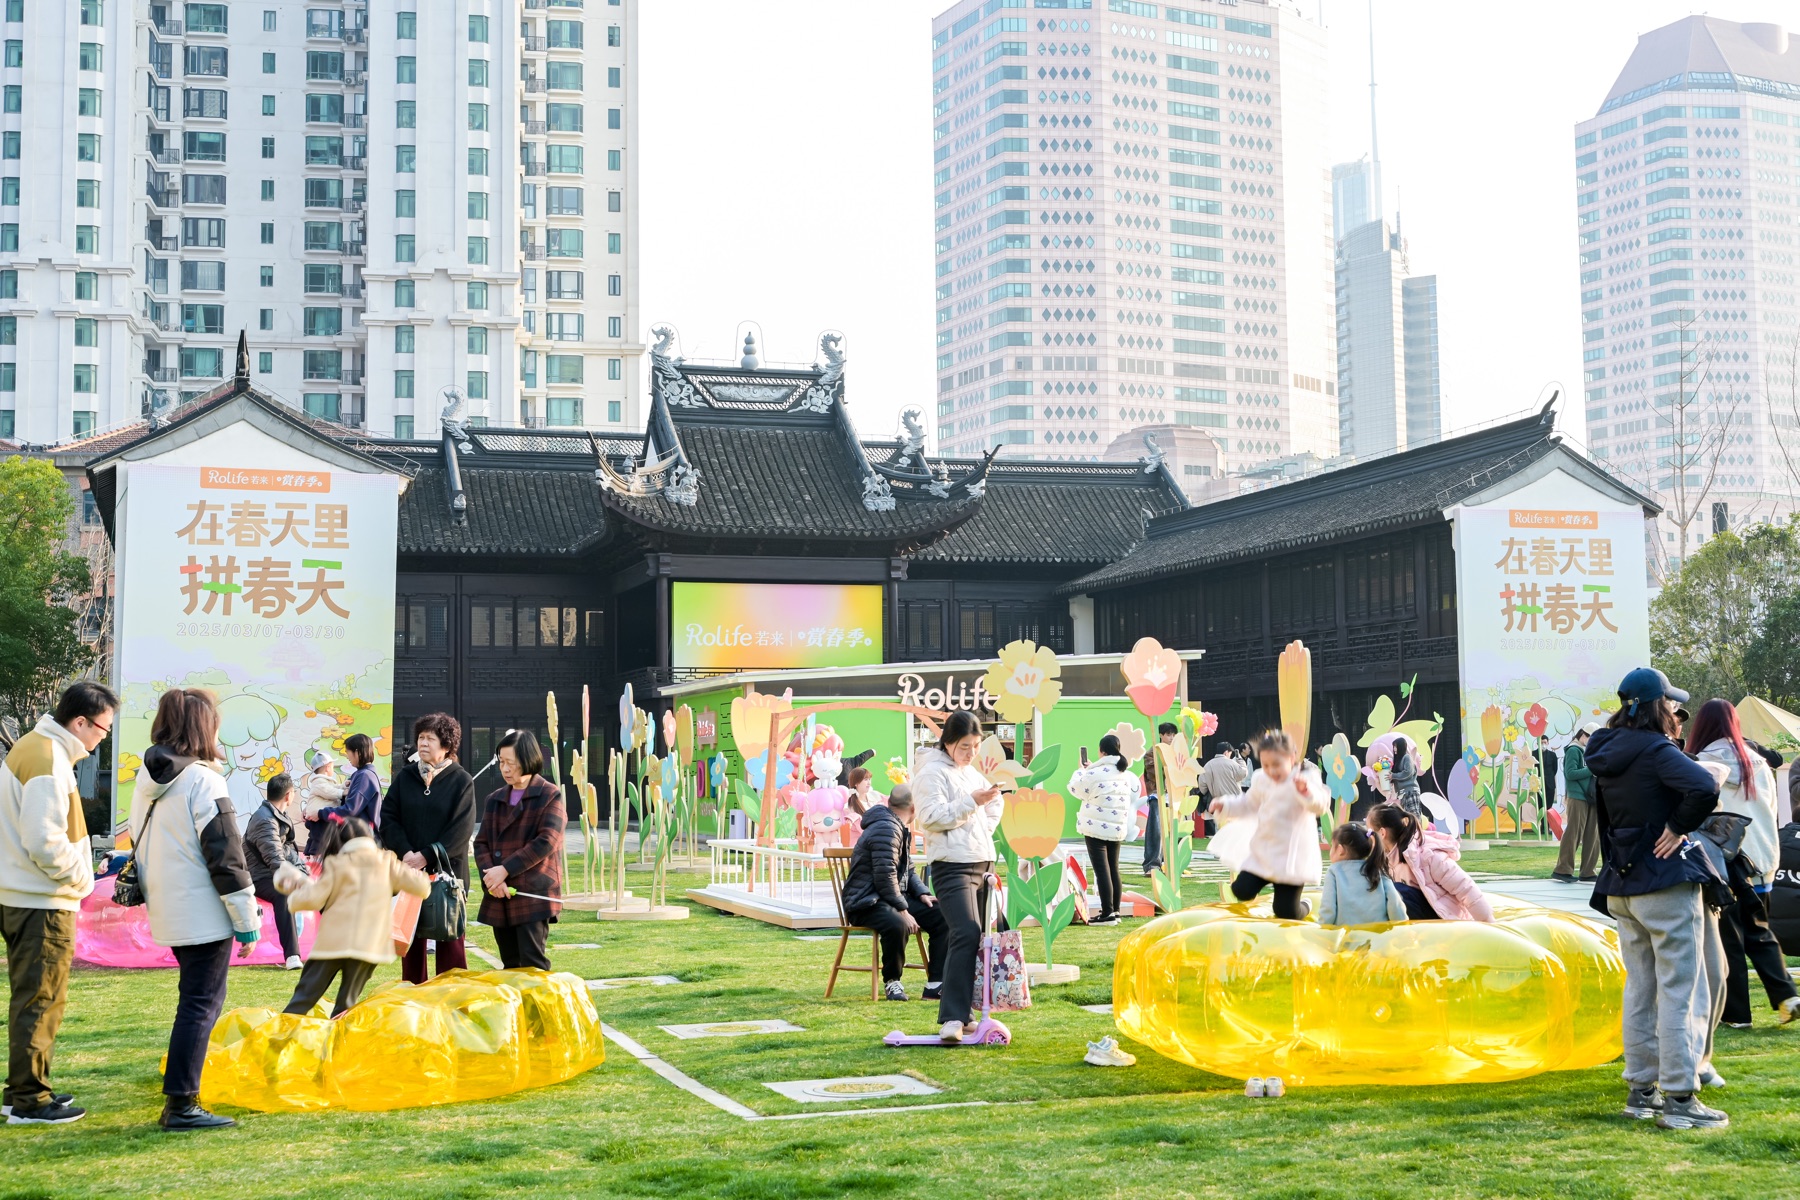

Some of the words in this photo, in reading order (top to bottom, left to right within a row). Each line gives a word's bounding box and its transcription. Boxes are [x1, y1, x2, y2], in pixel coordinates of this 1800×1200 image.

[208, 470, 249, 485] Rolife
[251, 475, 269, 485] 若来
[282, 474, 318, 488] 赏春季
[175, 500, 350, 549] 在春天里
[1514, 512, 1543, 524] Rolife
[1495, 536, 1615, 576] 在春天里
[180, 555, 350, 620] 拼春天
[1499, 582, 1619, 635] 拼春天
[176, 622, 346, 640] 2025/03/07-03/30
[685, 623, 753, 647] Rolife
[755, 630, 785, 647] 若来
[806, 627, 866, 648] 赏春季
[1500, 638, 1617, 651] 2025/03/07-03/30
[897, 673, 1002, 711] Rolife
